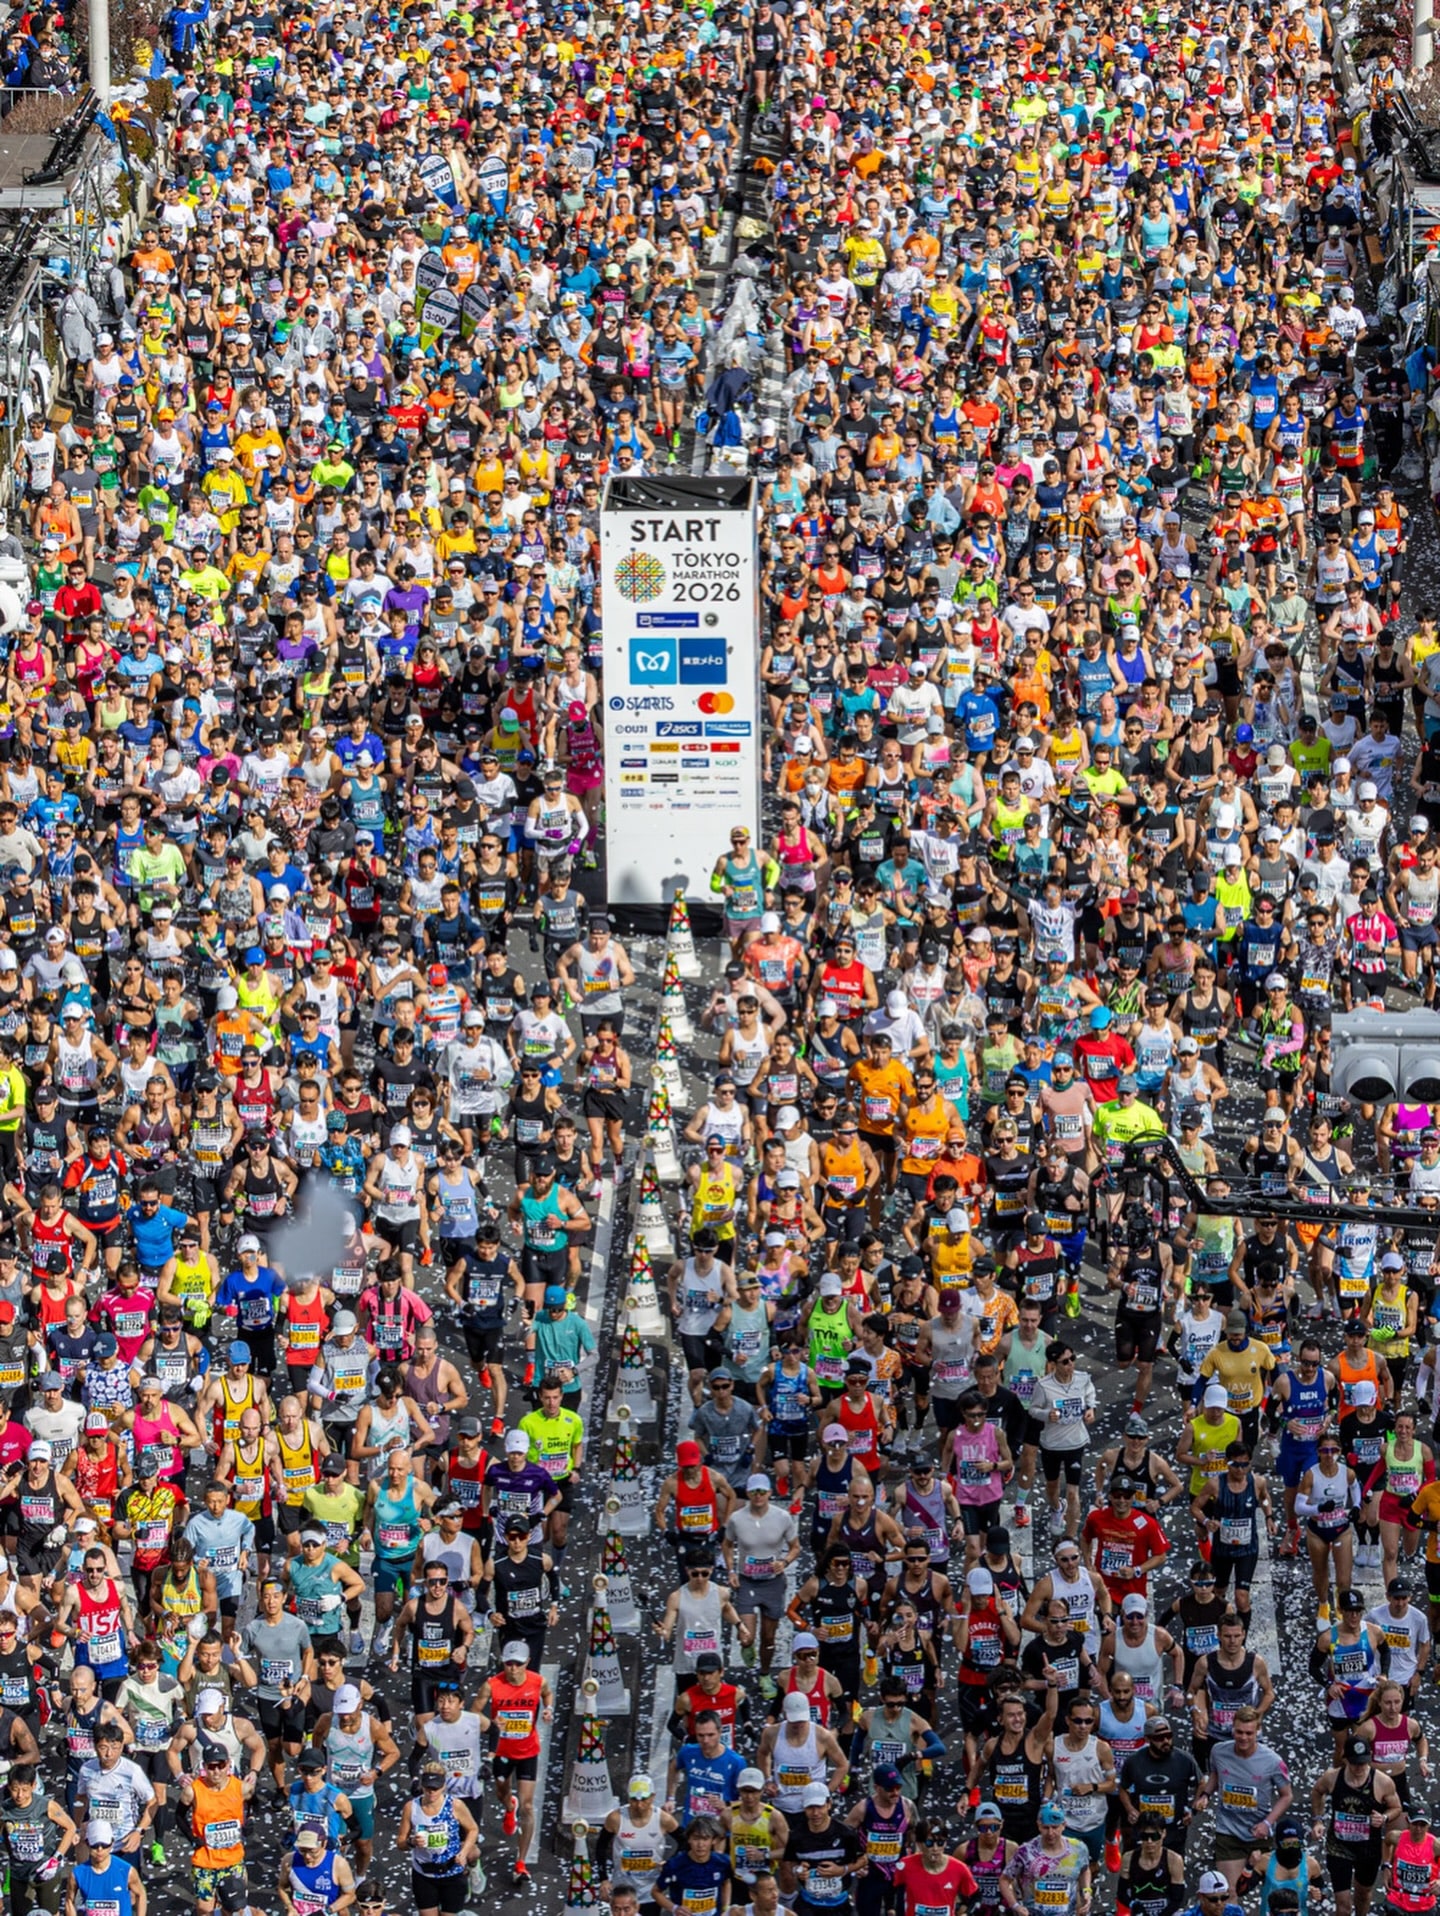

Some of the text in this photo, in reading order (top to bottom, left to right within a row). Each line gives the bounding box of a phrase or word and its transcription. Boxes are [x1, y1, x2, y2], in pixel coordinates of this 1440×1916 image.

[431, 172, 450, 187] 3:10
[488, 179, 506, 191] 3:10
[425, 310, 447, 326] 3:00
[630, 519, 721, 542] START
[672, 552, 740, 567] TOKYO
[672, 570, 740, 579] MARATHON
[672, 582, 741, 602] 2026
[1300, 1391, 1317, 1400] BEN
[573, 1773, 607, 1785] TOKYO
[572, 1785, 608, 1793] MARATHON
